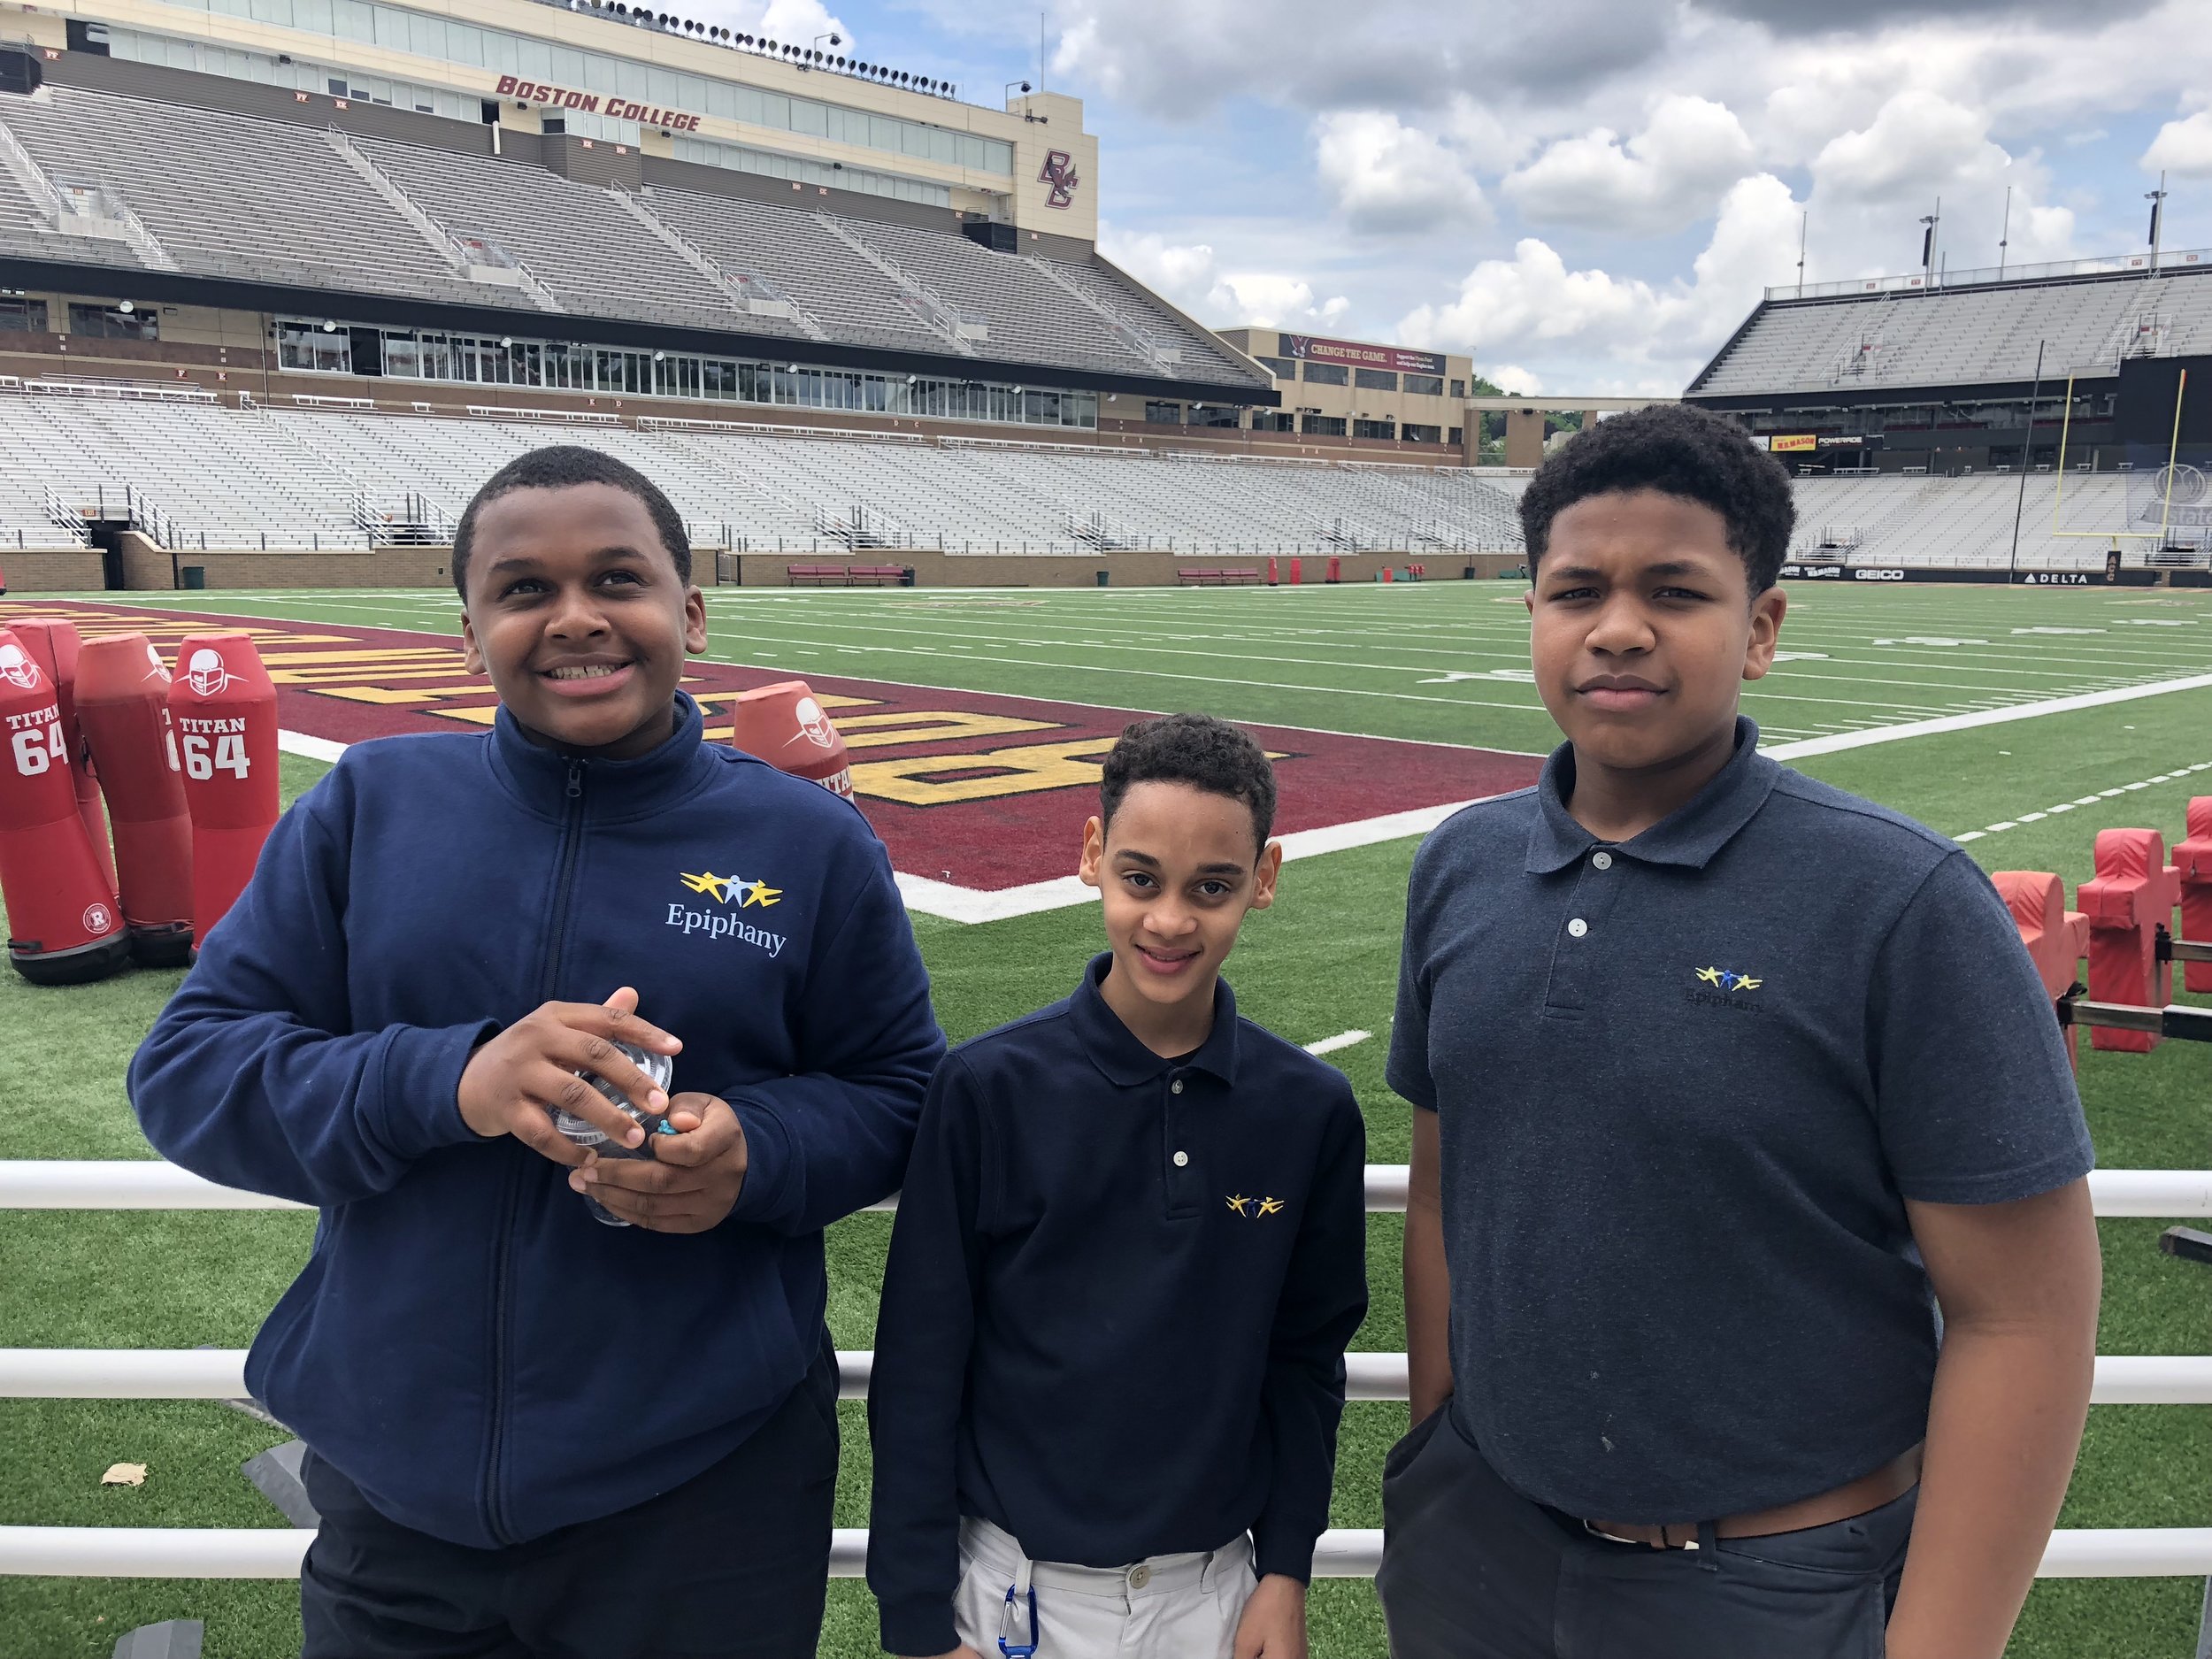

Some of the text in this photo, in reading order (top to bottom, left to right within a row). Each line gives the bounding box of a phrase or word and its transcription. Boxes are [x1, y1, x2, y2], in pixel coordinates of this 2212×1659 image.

[495, 75, 702, 132] BOSTON COLLEGE
[1310, 344, 1387, 363] CHANGE THE GAME.
[1855, 569, 1904, 580] GEICO
[2039, 573, 2088, 584] DELTA
[5, 703, 60, 730] TITAN
[179, 717, 246, 733] TITAN
[12, 719, 69, 777] 64
[182, 733, 250, 780] 64
[664, 902, 787, 958] Epiphany
